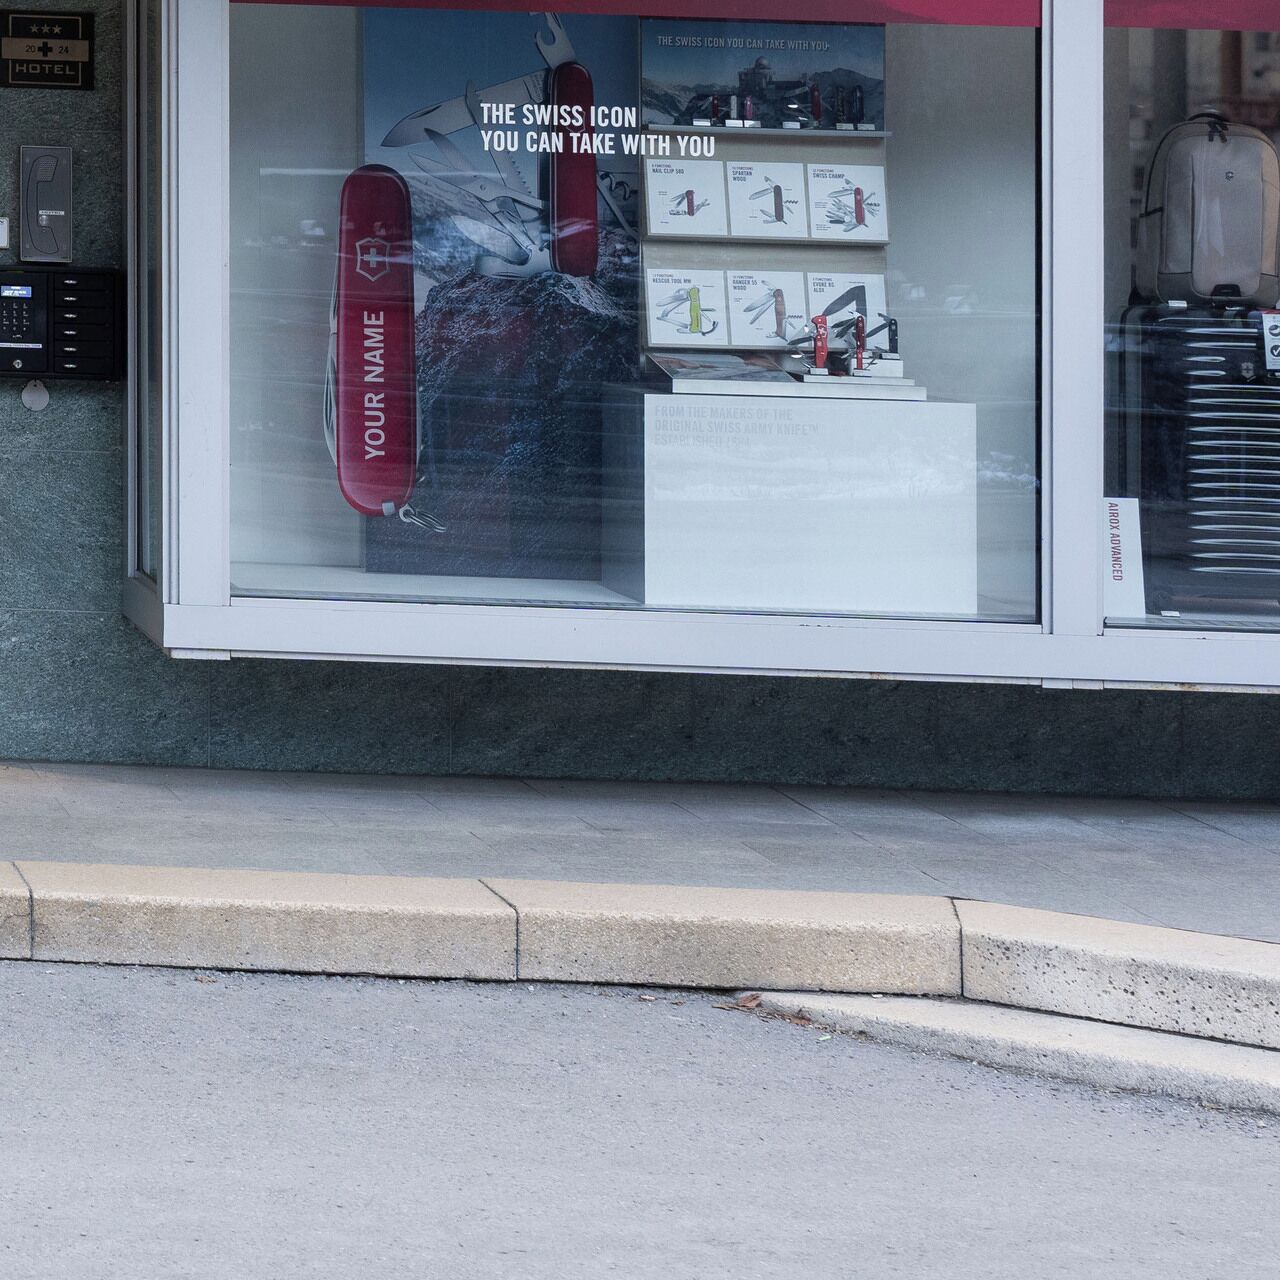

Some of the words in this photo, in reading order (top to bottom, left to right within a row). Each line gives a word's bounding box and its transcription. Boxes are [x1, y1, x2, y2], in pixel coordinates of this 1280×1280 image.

[25, 45, 36, 53] 20
[58, 46, 69, 54] 24
[657, 36, 673, 46] THE
[675, 36, 702, 47] SWISS
[704, 37, 725, 48] ICON
[727, 38, 744, 48] YOU
[746, 38, 763, 49] CAN
[765, 39, 785, 50] TAKE
[788, 39, 809, 50] WITH
[15, 63, 75, 74] HOTEL
[480, 103, 515, 124] THE
[523, 104, 583, 127] SWISS
[590, 106, 636, 128] ICON
[480, 131, 519, 152] YOU
[526, 131, 564, 153] CAN
[570, 133, 615, 154] TAKE
[622, 134, 670, 156] WITH
[676, 136, 715, 157] YOU
[364, 310, 385, 382] NAME
[365, 392, 386, 460] YOUR
[654, 406, 685, 418] FROM
[687, 406, 708, 418] THE
[710, 406, 753, 420] MAKERS
[756, 408, 769, 420] OF
[773, 408, 793, 421] THE
[654, 419, 704, 433] ORIGINAL
[706, 421, 741, 434] SWISS
[743, 422, 774, 435] ARMY
[1108, 502, 1120, 530] AIROX
[1110, 533, 1123, 581] ADVANCED
